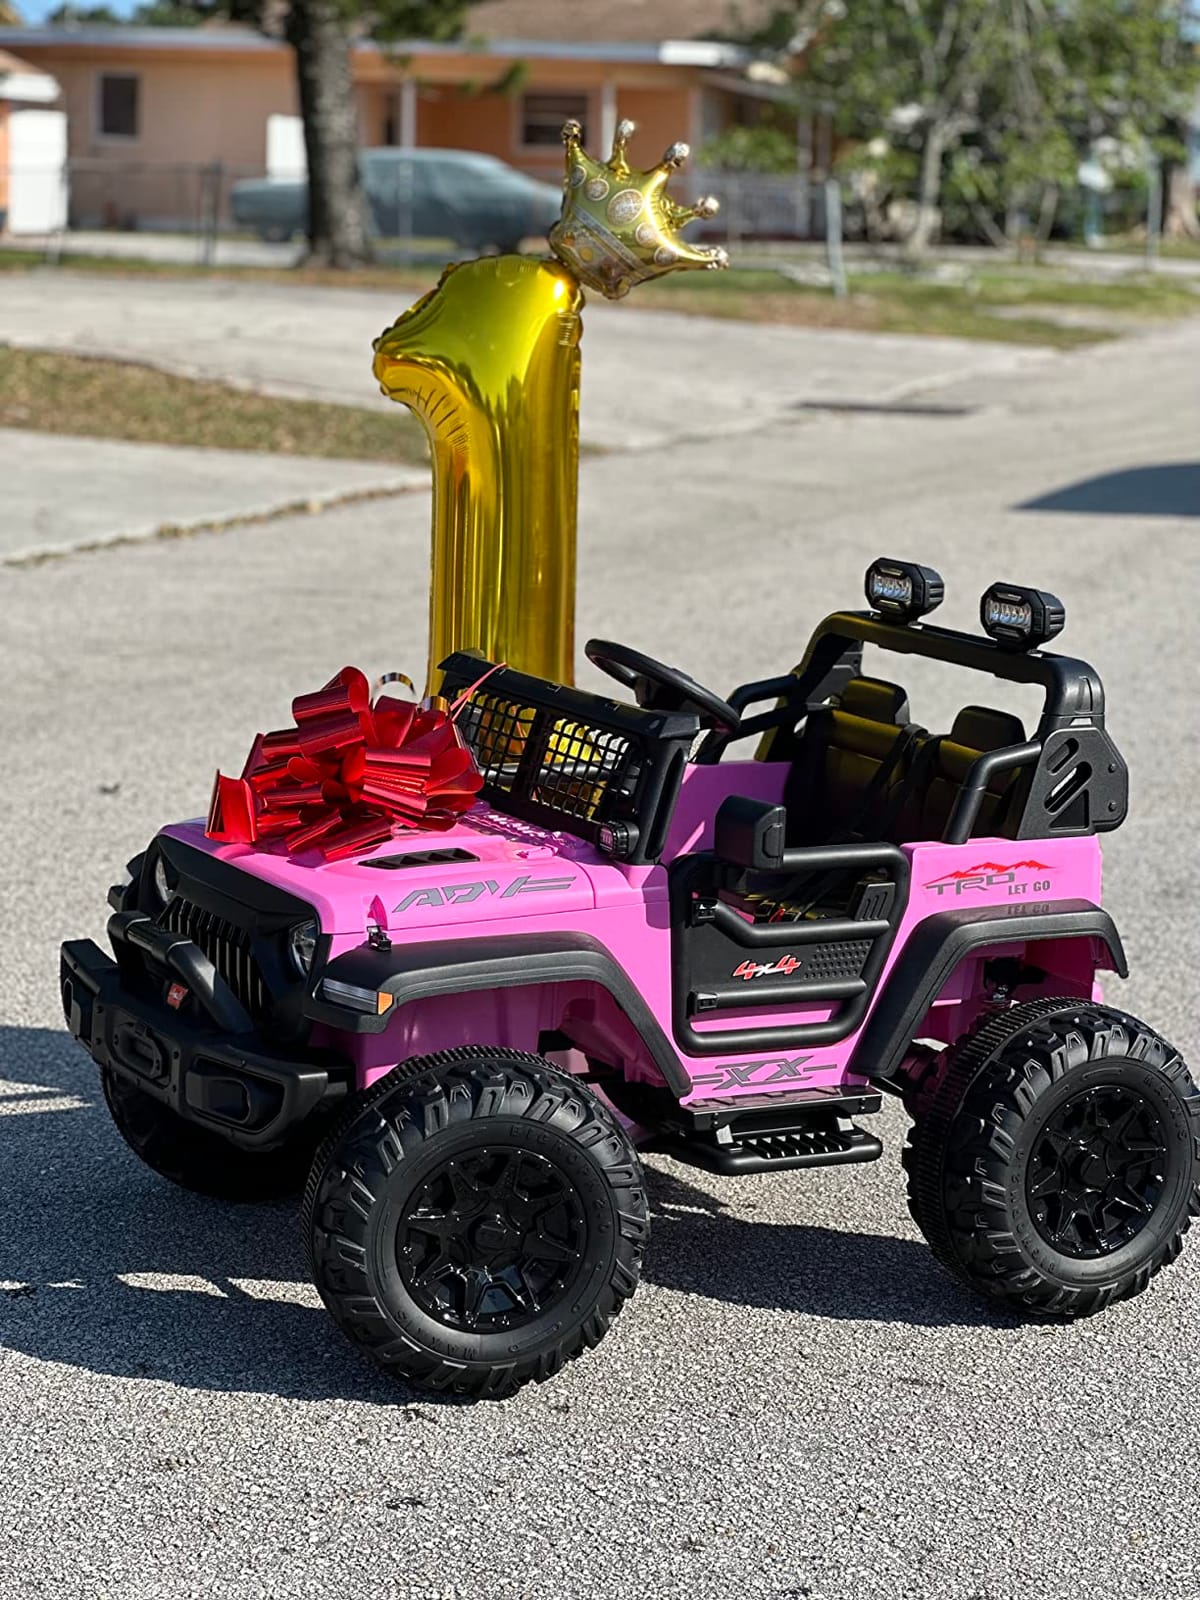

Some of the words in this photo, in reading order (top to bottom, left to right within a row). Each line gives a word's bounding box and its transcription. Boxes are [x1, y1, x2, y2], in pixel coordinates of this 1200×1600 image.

[926, 872, 1016, 895] TRD
[1008, 883, 1029, 896] LET
[1033, 880, 1051, 892] GO
